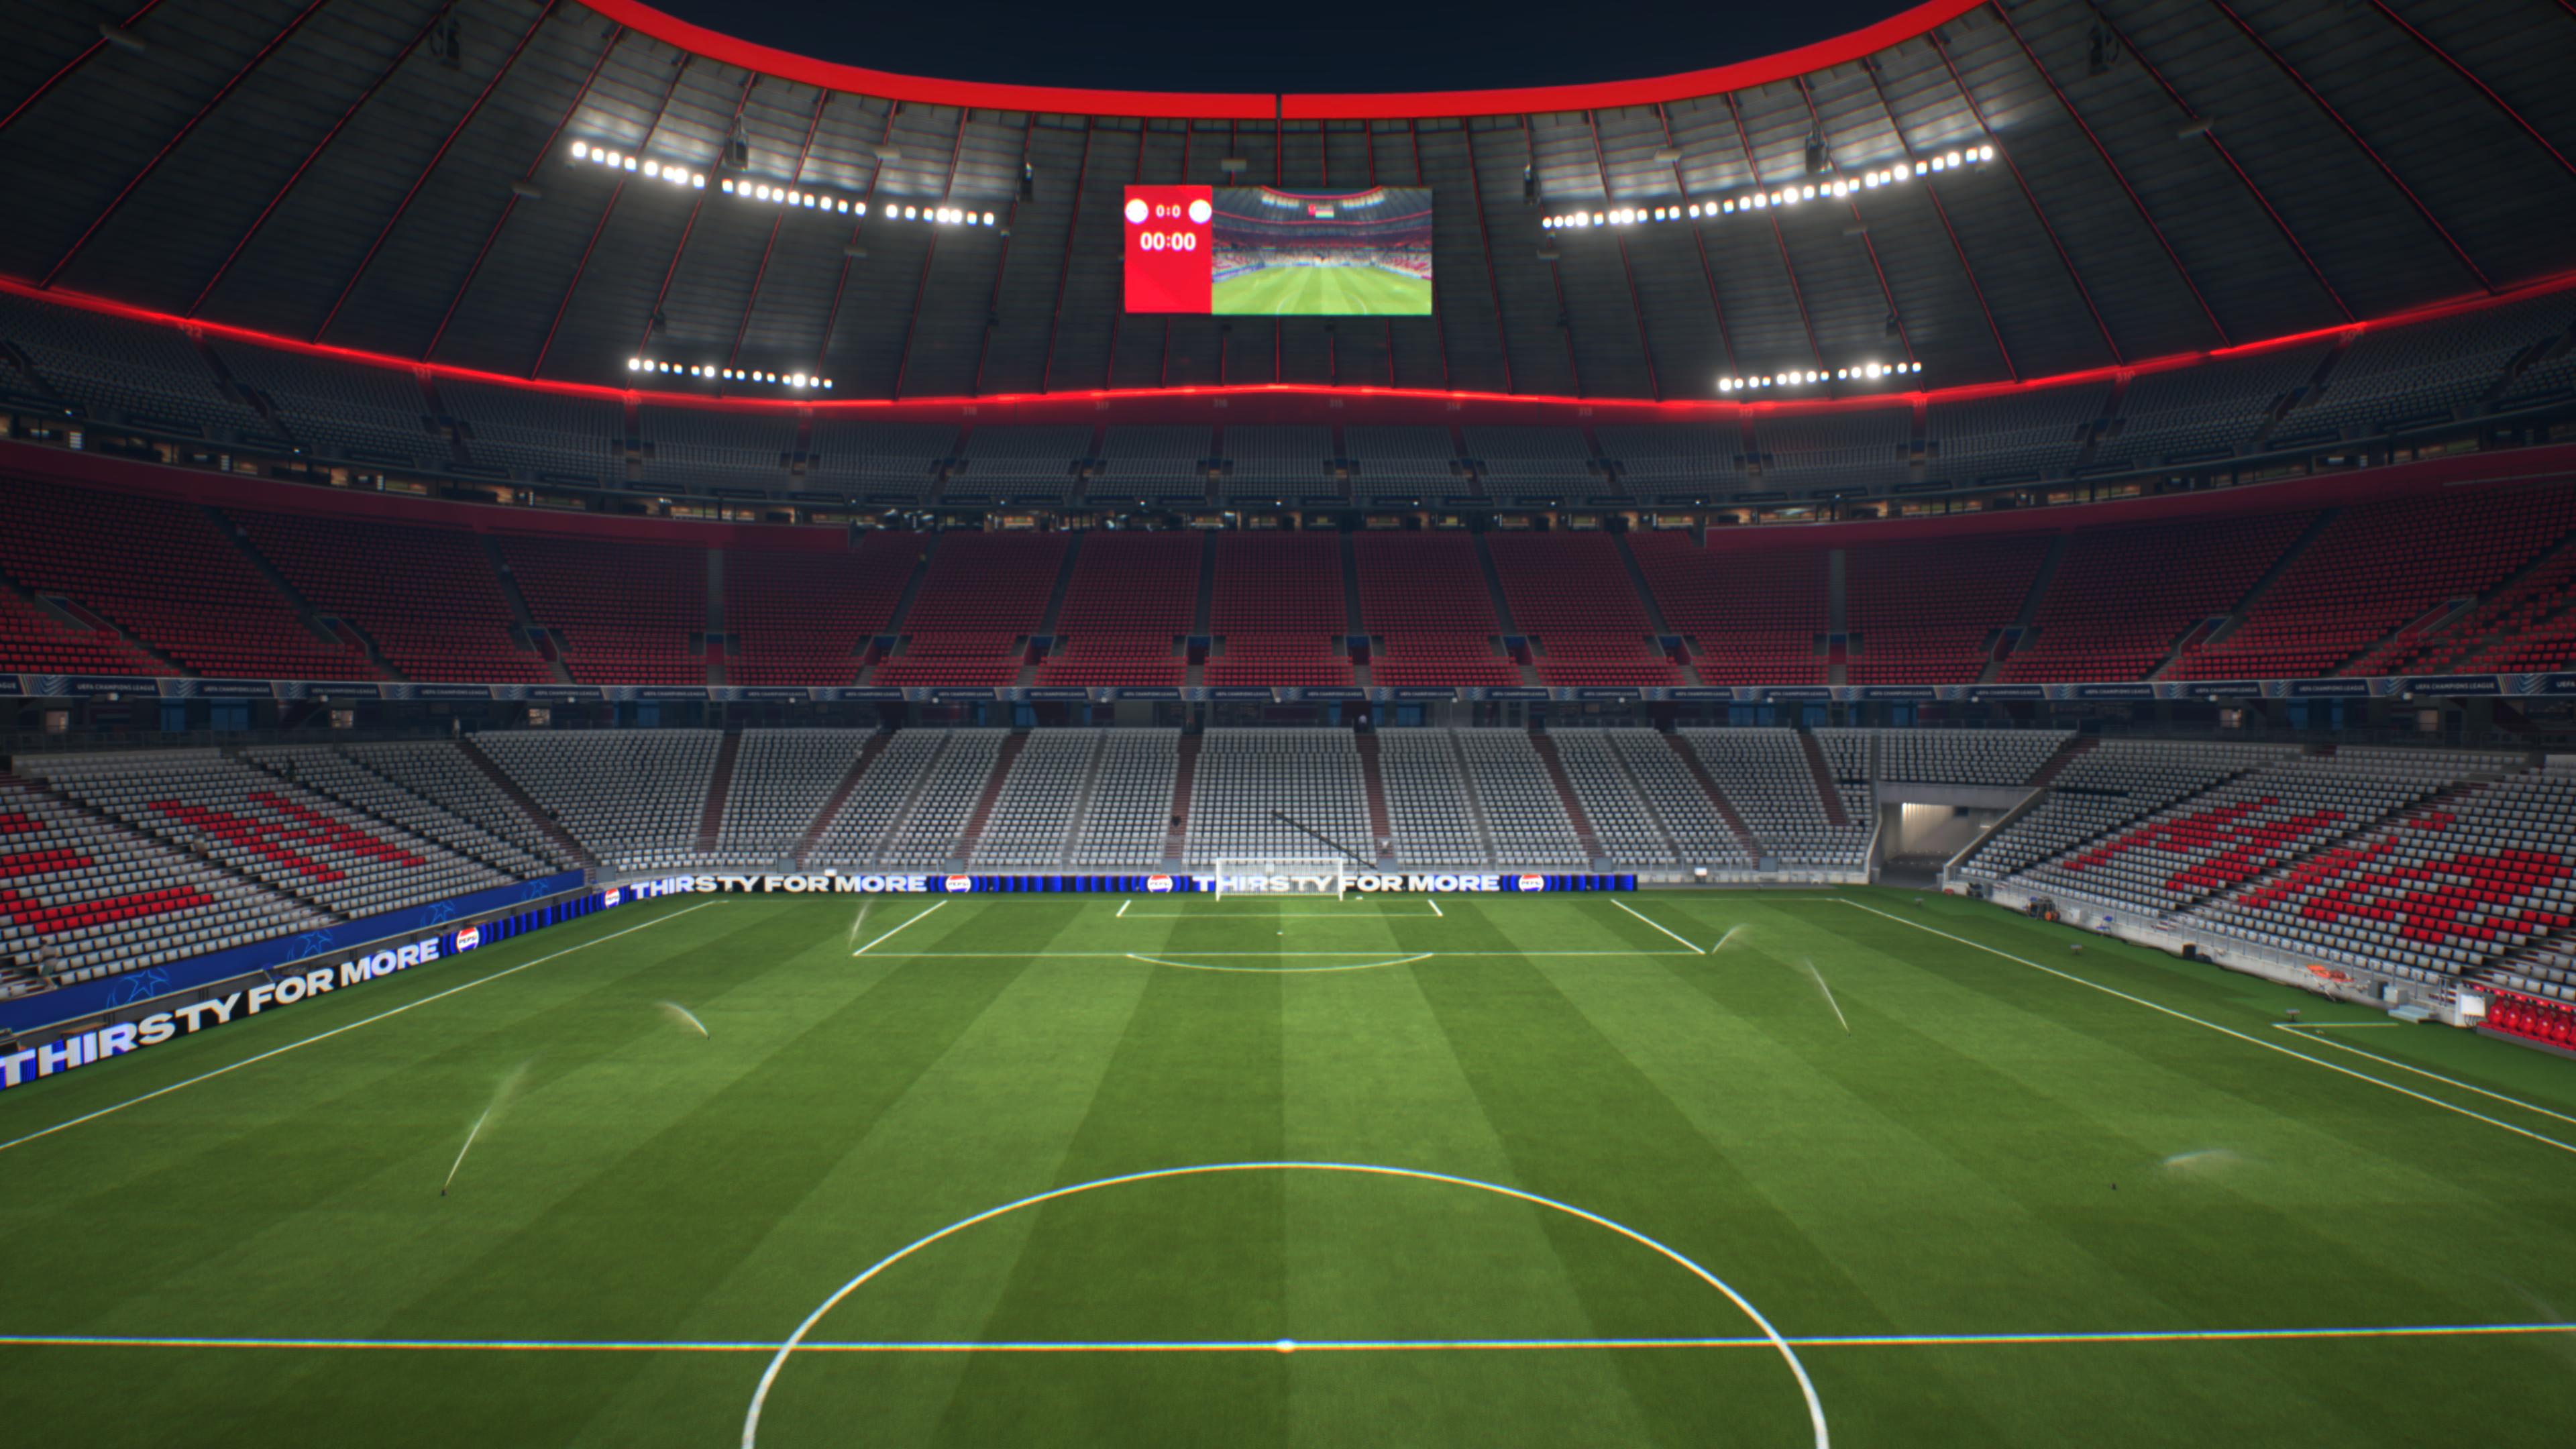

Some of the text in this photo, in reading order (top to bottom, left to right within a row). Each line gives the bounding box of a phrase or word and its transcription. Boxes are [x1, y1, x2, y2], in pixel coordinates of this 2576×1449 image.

[1156, 205, 1181, 218] 0:0
[1140, 231, 1196, 251] 00:00
[630, 875, 927, 900] THIRSTY FOR MORE
[1192, 875, 1500, 892] THIRSTY FOR MORE
[0, 936, 440, 1087] THIRSTY FOR MORE
